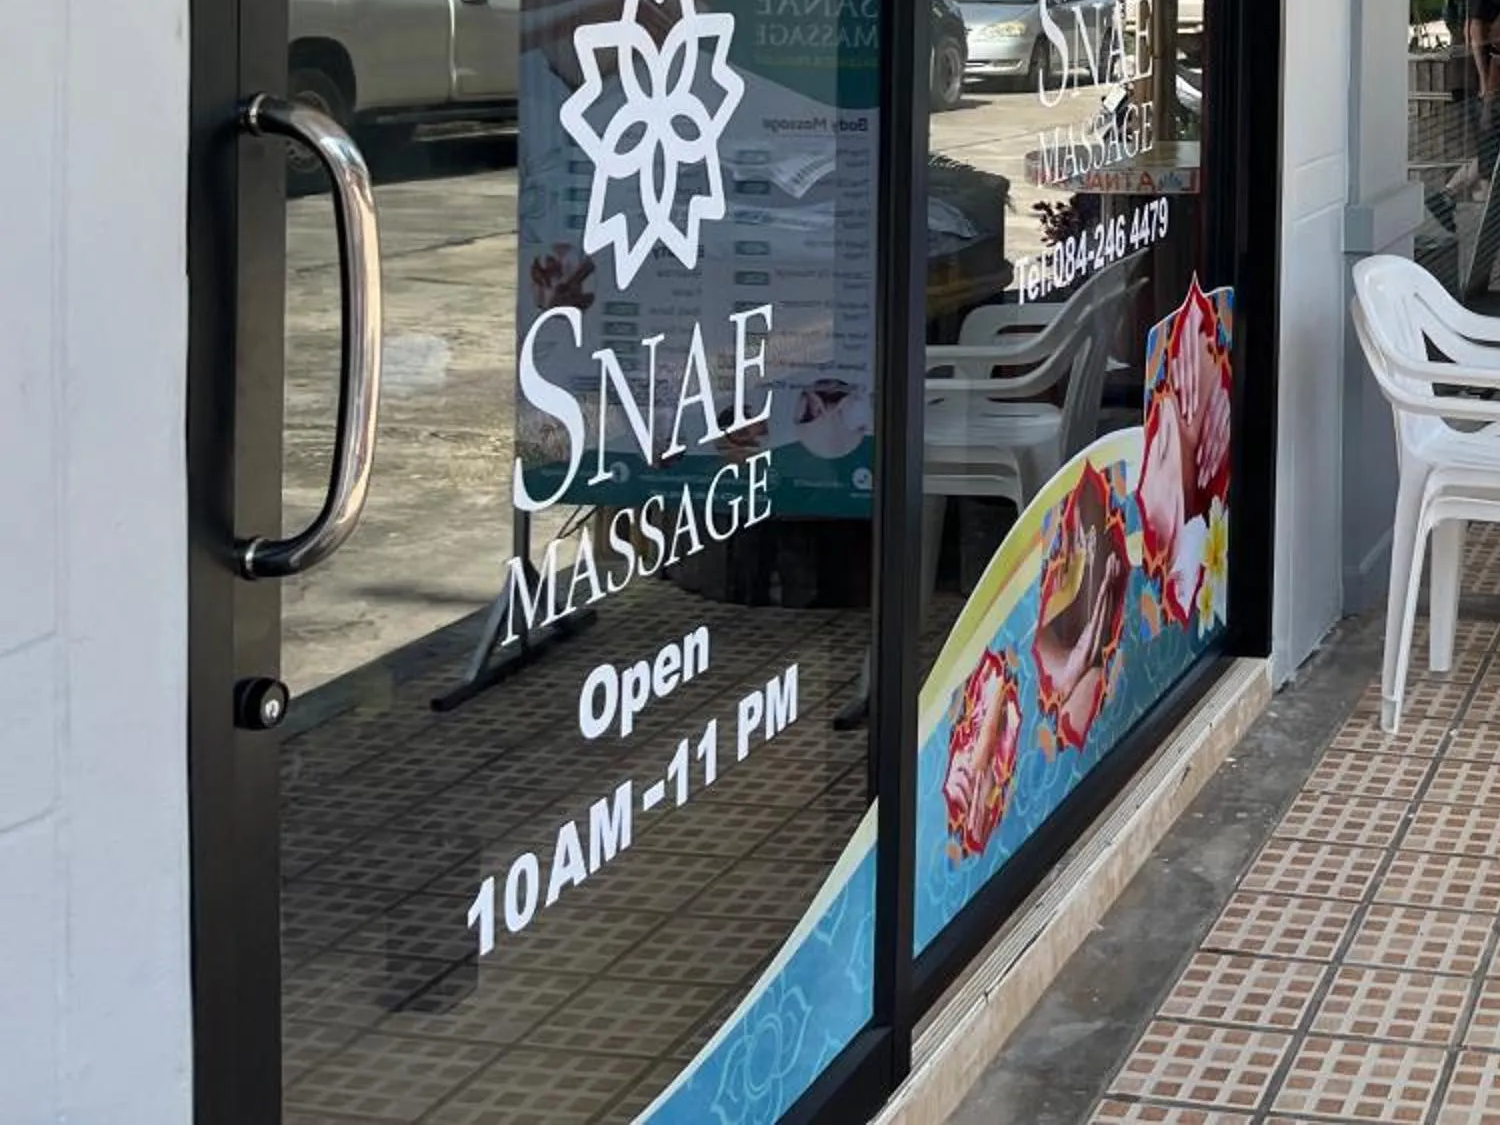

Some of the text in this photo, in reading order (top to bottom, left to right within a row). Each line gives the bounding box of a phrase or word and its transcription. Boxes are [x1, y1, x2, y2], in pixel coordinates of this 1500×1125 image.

[1038, 101, 1153, 187] MASSAGE
[1129, 196, 1169, 250] 4479
[514, 305, 773, 513] SNAE
[502, 451, 773, 647] MASSAGE
[579, 625, 709, 740] Open
[737, 663, 799, 762] PM
